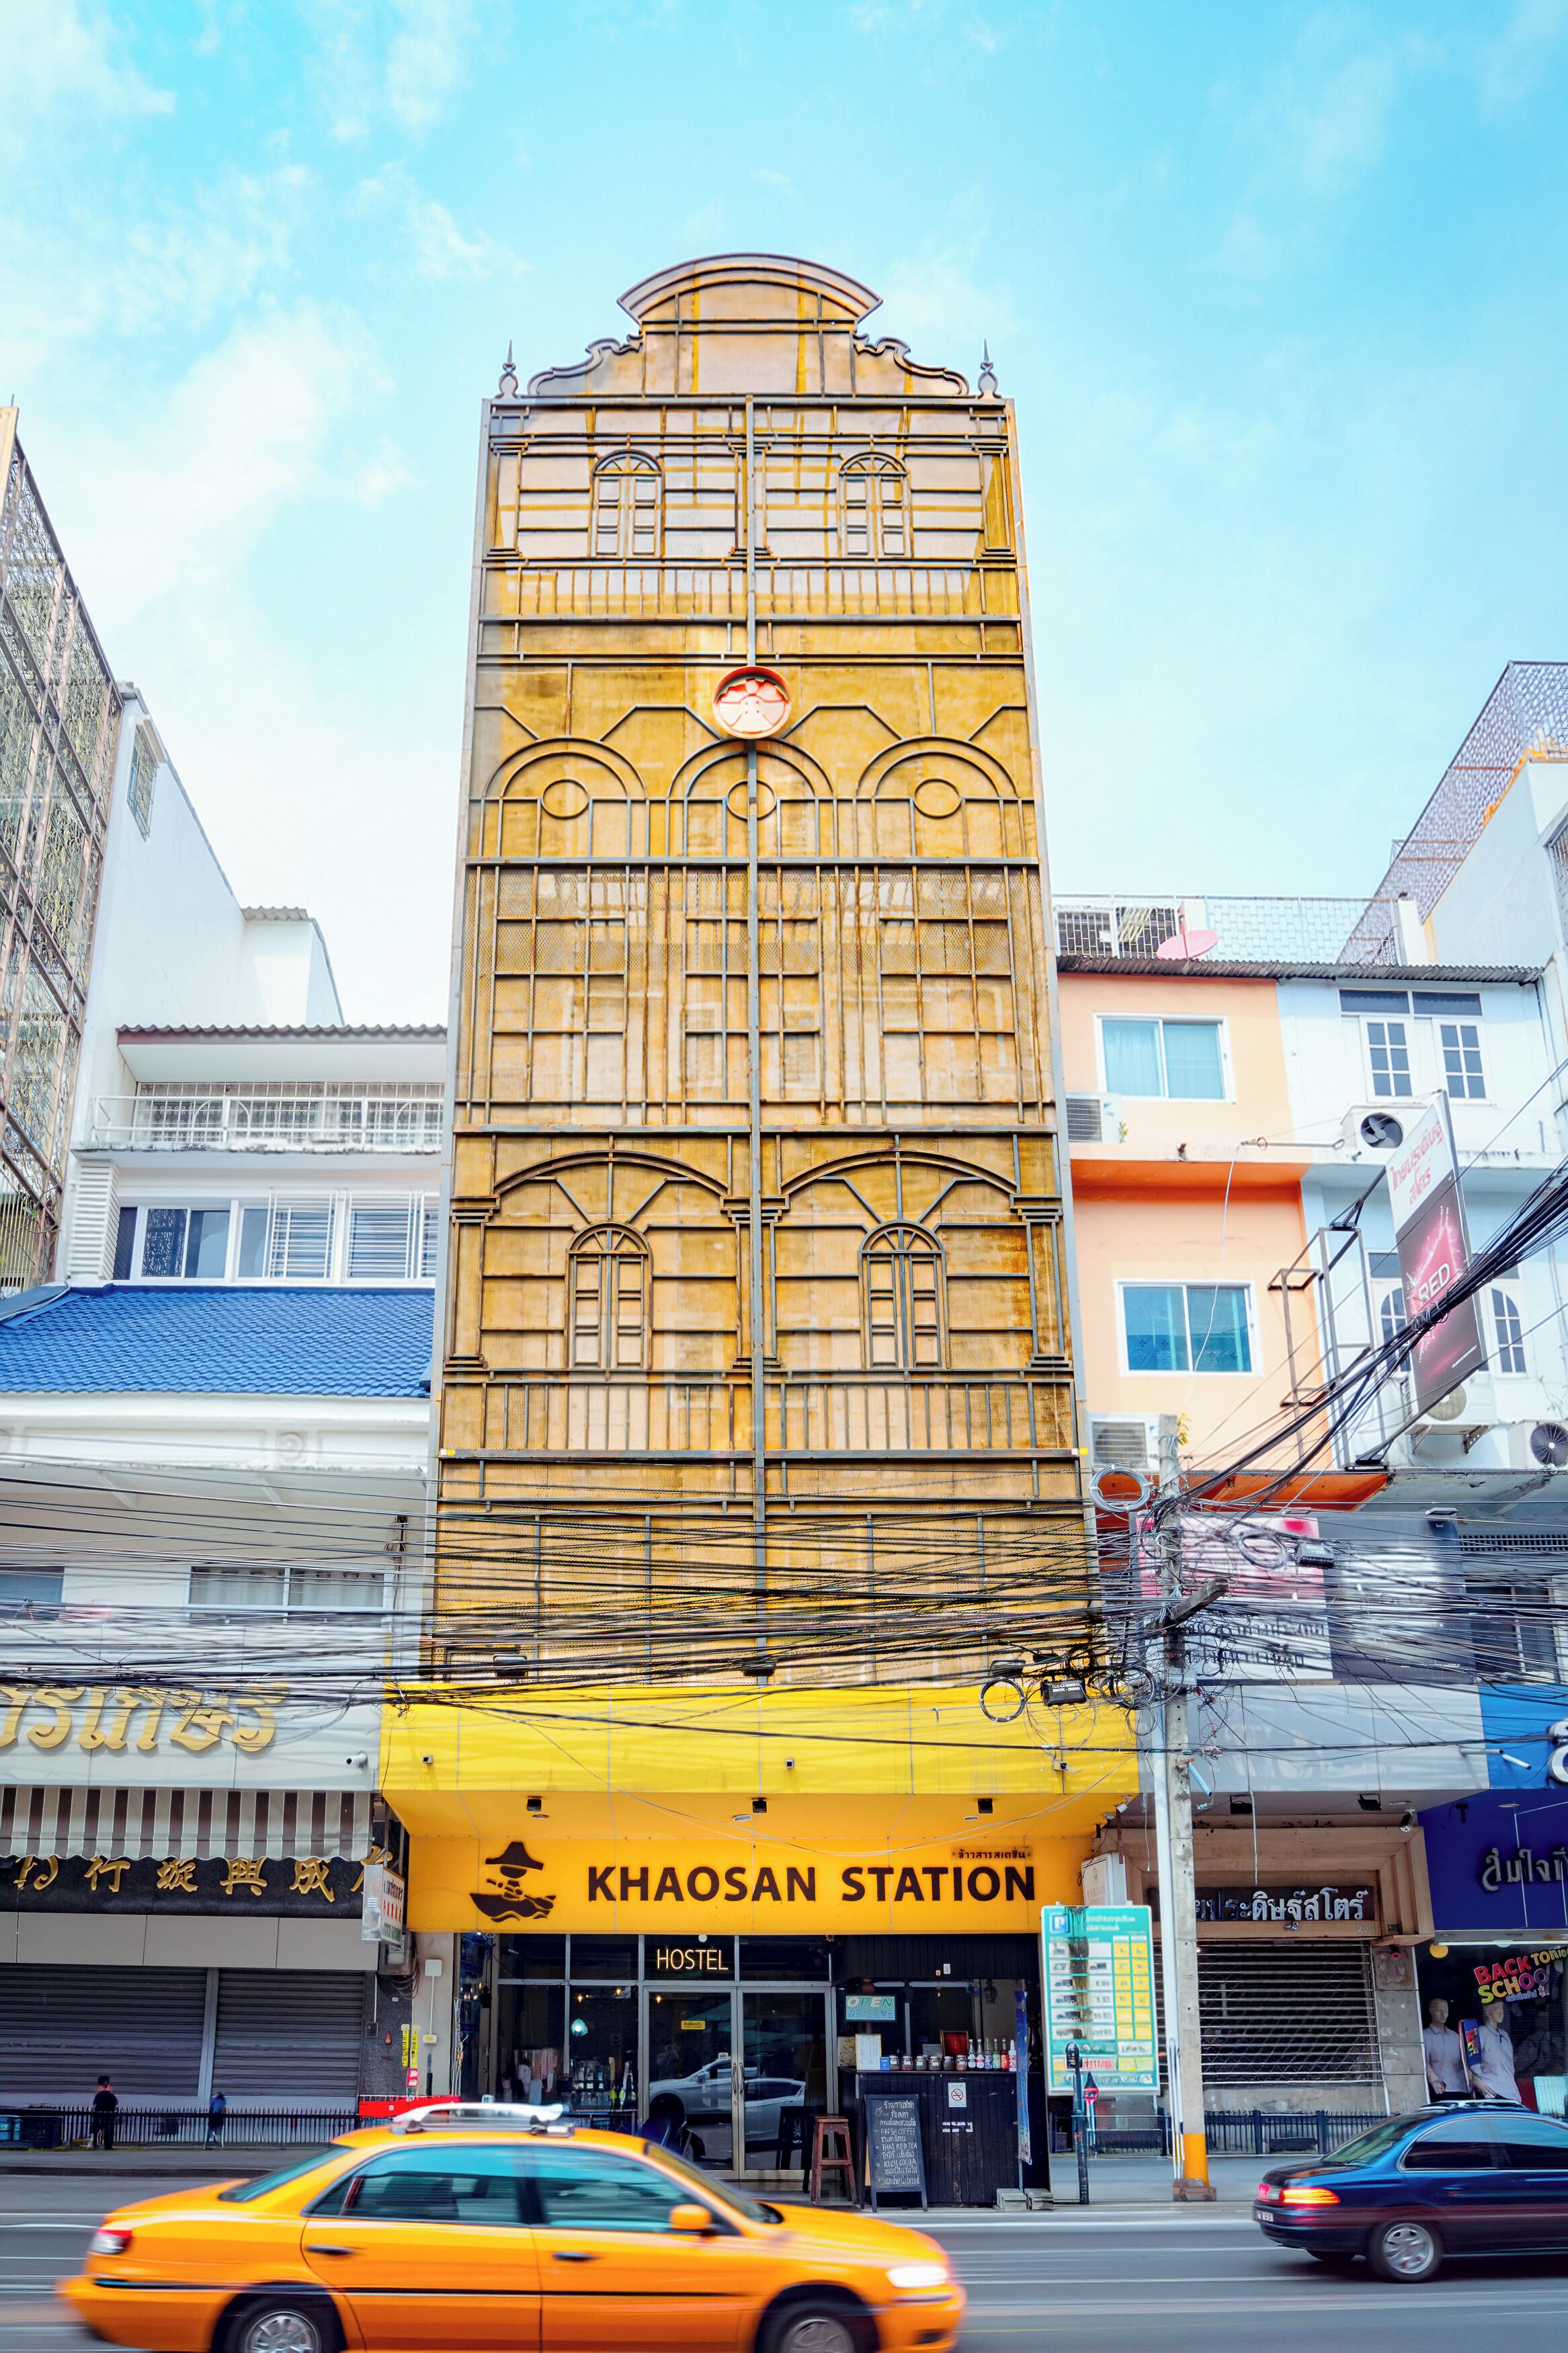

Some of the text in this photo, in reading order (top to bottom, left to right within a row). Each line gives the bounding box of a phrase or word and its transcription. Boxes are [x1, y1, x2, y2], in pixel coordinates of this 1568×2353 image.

[1418, 1263, 1451, 1306] RED
[588, 1866, 1035, 1902] KHAOSAN STATION
[657, 1949, 728, 1970] HOSTEL
[1474, 1956, 1532, 1985] BACK
[848, 1997, 893, 2007] OPEN
[848, 2009, 893, 2019] WELCOME
[884, 2160, 898, 2168] RICH
